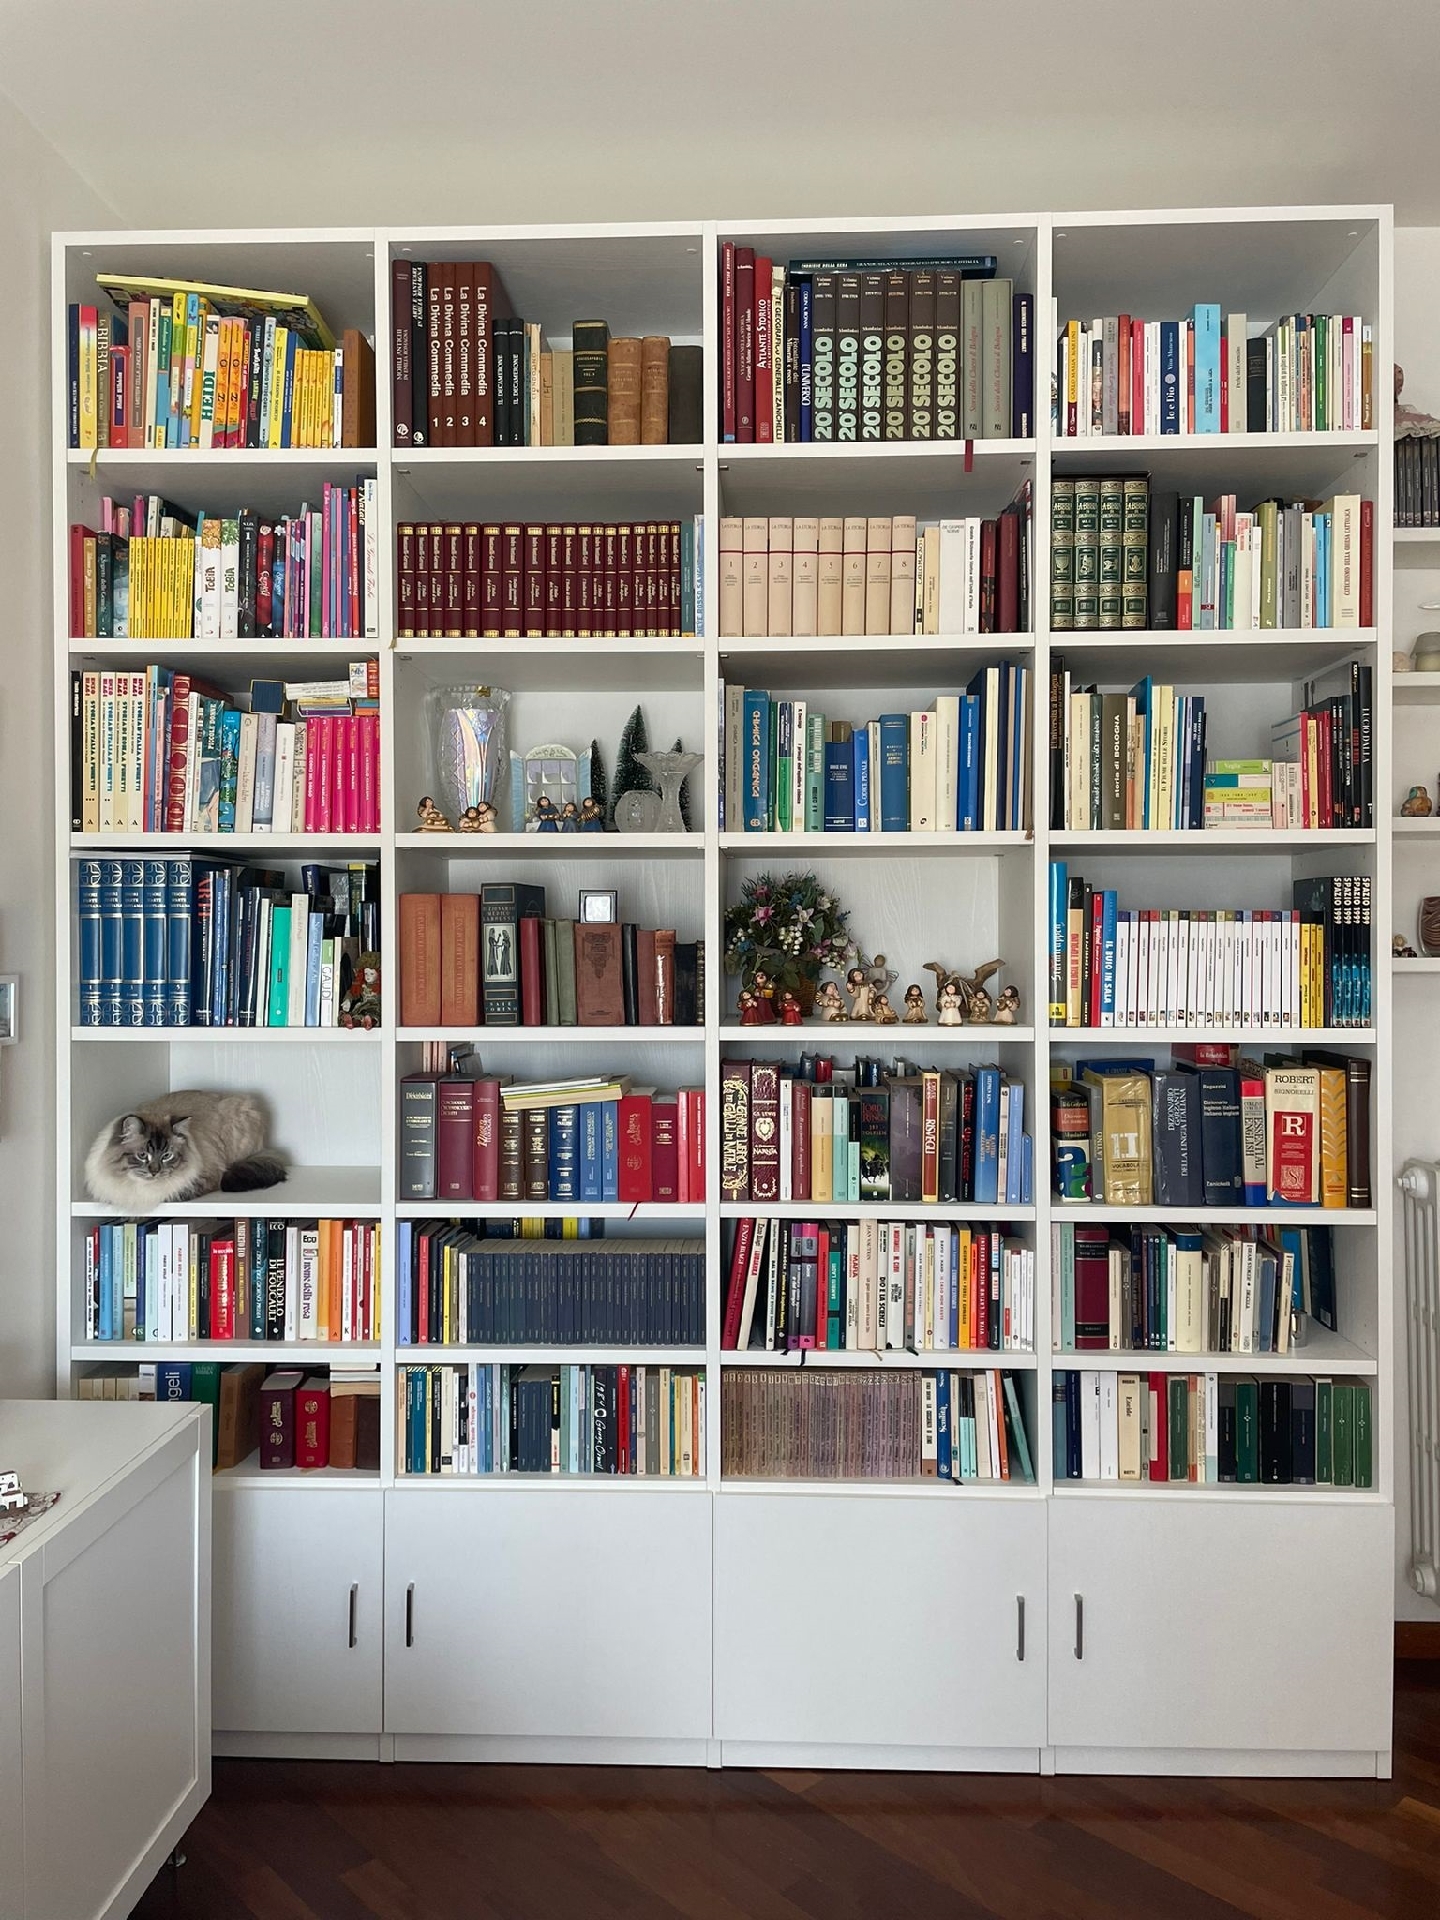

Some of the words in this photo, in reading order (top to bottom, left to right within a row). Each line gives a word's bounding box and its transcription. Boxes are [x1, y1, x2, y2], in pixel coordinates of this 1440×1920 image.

[430, 287, 439, 300] La
[444, 287, 453, 300] La
[460, 287, 470, 300] La
[478, 287, 487, 300] La
[430, 304, 439, 336] Divina
[444, 304, 453, 336] Divina
[460, 304, 470, 336] Divina
[478, 304, 487, 336] Divina
[757, 299, 767, 331] STORICO
[98, 328, 108, 372] BIBBIA
[757, 333, 767, 369] ATLANTE
[430, 339, 439, 396] Commedia
[444, 339, 453, 396] Commedia
[460, 339, 470, 396] Commedia
[478, 339, 487, 396] Commedia
[814, 337, 833, 409] SECOLO
[838, 337, 859, 410] SECOLO
[862, 335, 882, 408] SECOLO
[886, 335, 905, 408] SECOLO
[912, 334, 933, 407] SECOLO
[937, 334, 957, 407] SECOLO
[202, 369, 215, 421] HEIDI
[801, 364, 810, 405] L'UNIVERSO
[1166, 387, 1175, 402] Dio
[434, 416, 438, 427] 1
[447, 416, 453, 427] 2
[462, 416, 469, 427] 3
[480, 416, 487, 427] 4
[1166, 410, 1175, 420] Io
[1051, 673, 1059, 703] Bologna
[751, 710, 760, 746] CHIMICA
[1362, 735, 1370, 763] DALLA
[751, 749, 760, 798] ORGANICA
[1114, 761, 1120, 769] di
[1333, 877, 1342, 906] SPAZIO
[1343, 877, 1351, 906] SPAZIO
[1353, 877, 1361, 906] SPAZIO
[1362, 877, 1370, 906] SPAZIO
[1333, 907, 1342, 925] 1999
[1343, 907, 1351, 925] 1999
[1353, 907, 1361, 925] 1999
[1362, 907, 1370, 925] 1999
[1050, 922, 1065, 981] Sturmtruppen
[1105, 940, 1113, 948] IL
[1104, 950, 1113, 969] BUIO
[1104, 972, 1112, 983] IN
[1103, 985, 1111, 1004] SALA
[1274, 1075, 1314, 1084] ROBERT
[1274, 1088, 1314, 1096] SIGNORELLI
[1167, 1088, 1175, 1131] DIZIONARIO
[1179, 1088, 1187, 1123] ITALIANA
[925, 1118, 935, 1154] RISVEGLI
[1244, 1117, 1254, 1157] ENGLISH
[1284, 1117, 1305, 1134] R
[724, 1141, 737, 1172] NATALE
[1254, 1117, 1264, 1169] ESSENTIAL
[303, 1235, 317, 1243] Eco
[740, 1224, 749, 1244] ENZO
[238, 1248, 246, 1257] ECO
[268, 1259, 276, 1269] DI
[276, 1258, 284, 1268] IL
[218, 1255, 227, 1290] GIORGIO
[303, 1262, 312, 1281] nome
[268, 1271, 276, 1322] FOUCAULT
[276, 1269, 284, 1316] PENDOLO
[303, 1283, 313, 1300] della
[303, 1302, 312, 1319] rosa
[596, 1380, 606, 1405] 1984
[594, 1418, 606, 1443] George
[595, 1444, 606, 1469] Orwell
